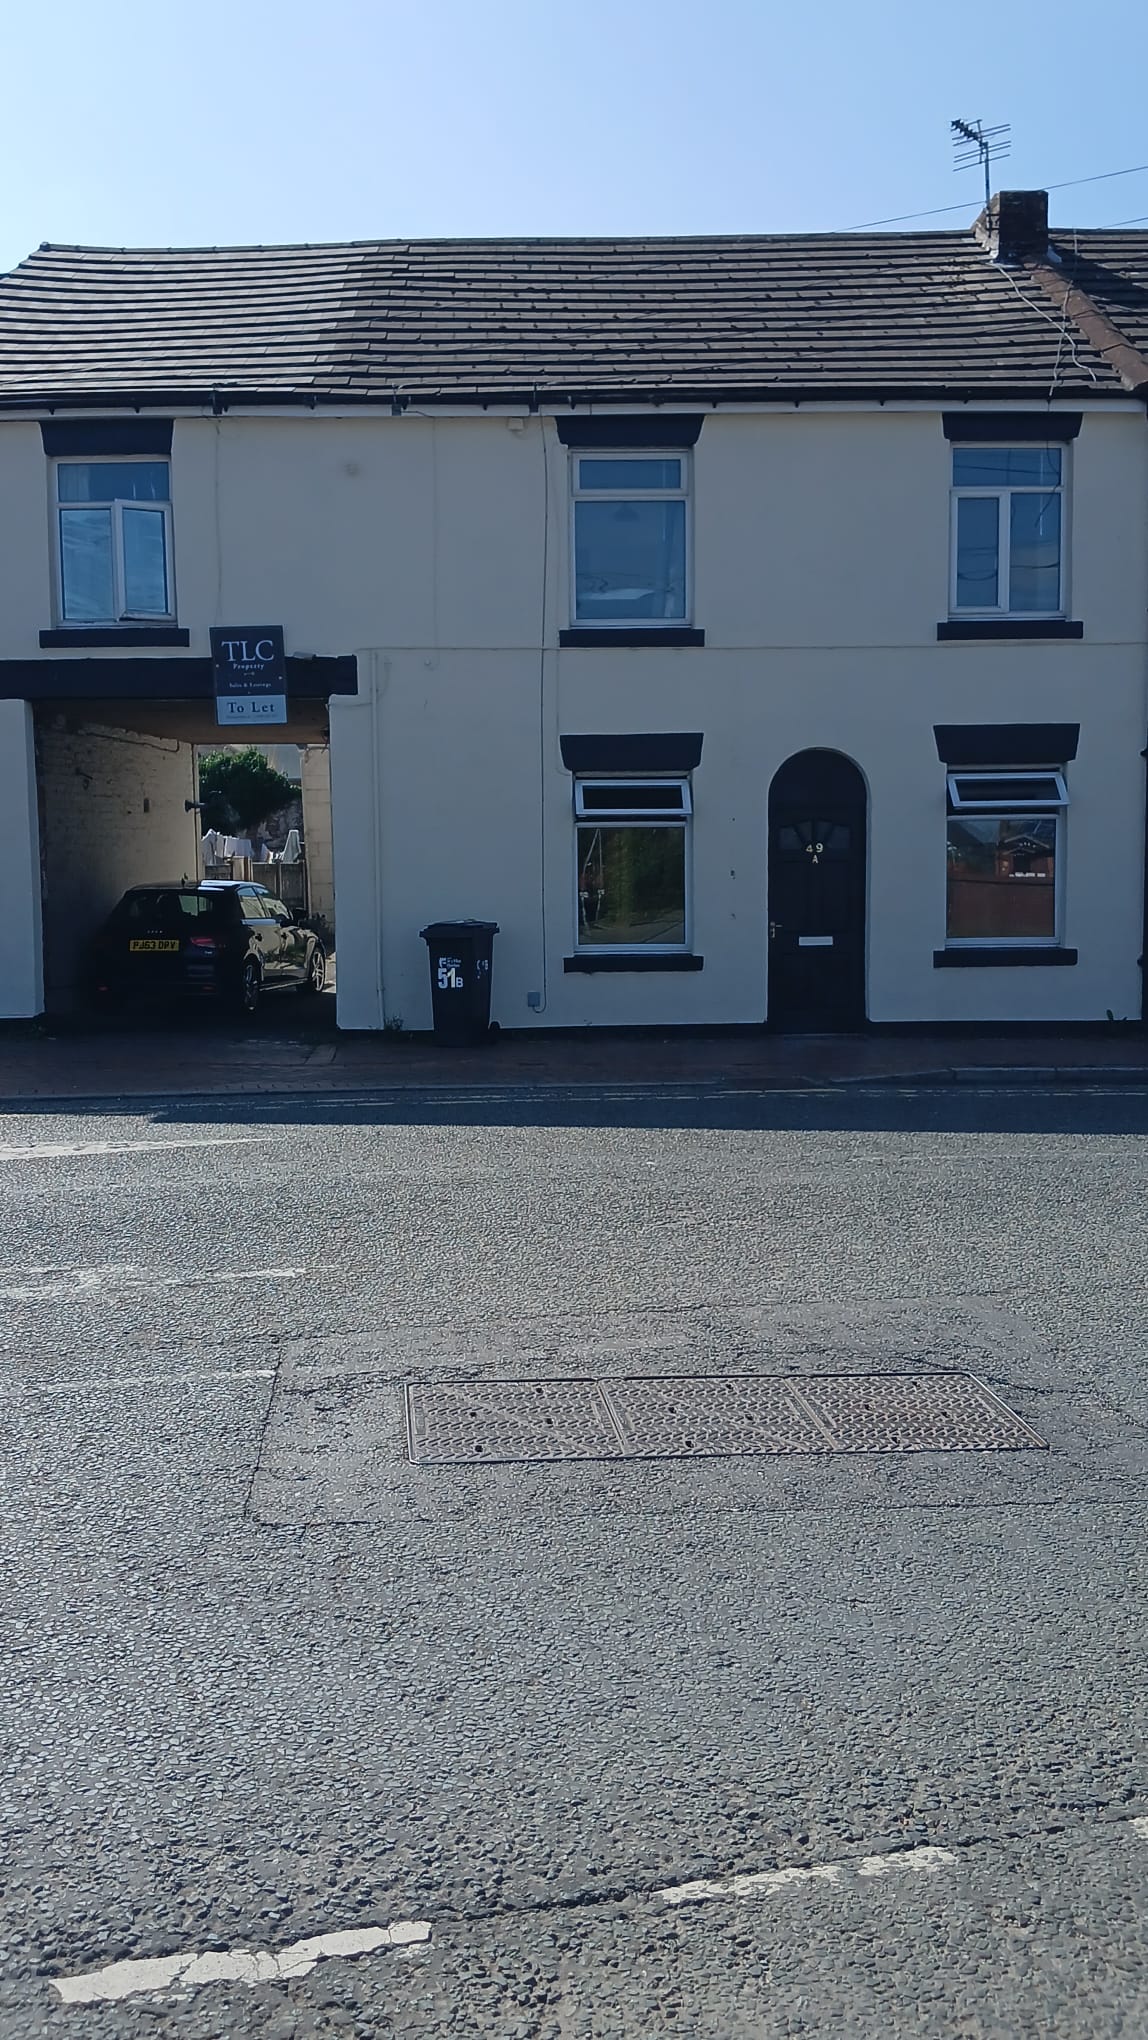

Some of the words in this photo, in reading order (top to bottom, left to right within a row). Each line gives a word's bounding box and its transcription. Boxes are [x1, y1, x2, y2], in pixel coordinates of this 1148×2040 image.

[221, 639, 274, 662] TLC
[227, 702, 244, 713] To
[251, 701, 275, 713] Let
[805, 842, 824, 853] 49
[812, 854, 819, 864] A
